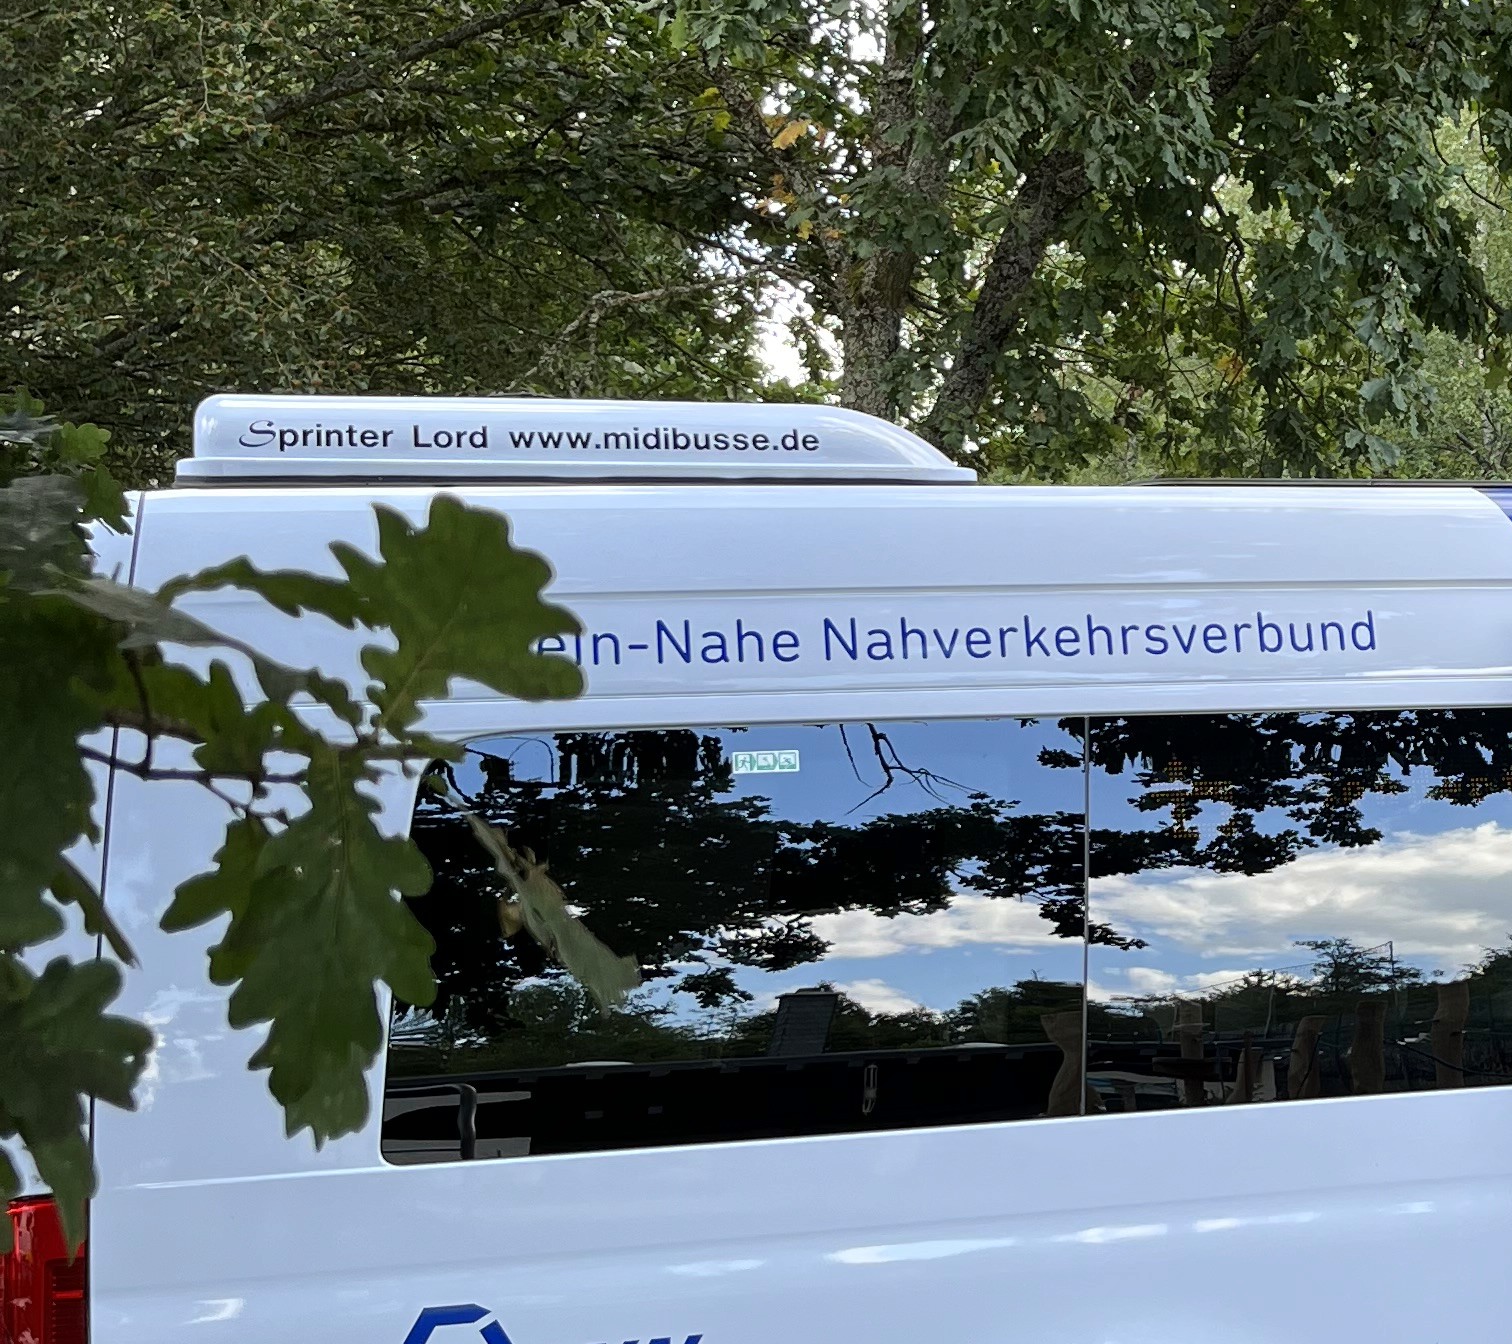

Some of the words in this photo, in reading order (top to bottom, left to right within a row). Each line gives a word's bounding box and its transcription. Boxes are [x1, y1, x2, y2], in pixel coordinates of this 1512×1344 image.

[238, 420, 394, 453] Sprinter
[413, 423, 489, 450] Lord
[508, 426, 820, 453] www.midibusse.de
[537, 618, 801, 666] ein-Nahe
[822, 610, 1378, 662] Nahverkehrsverbund
